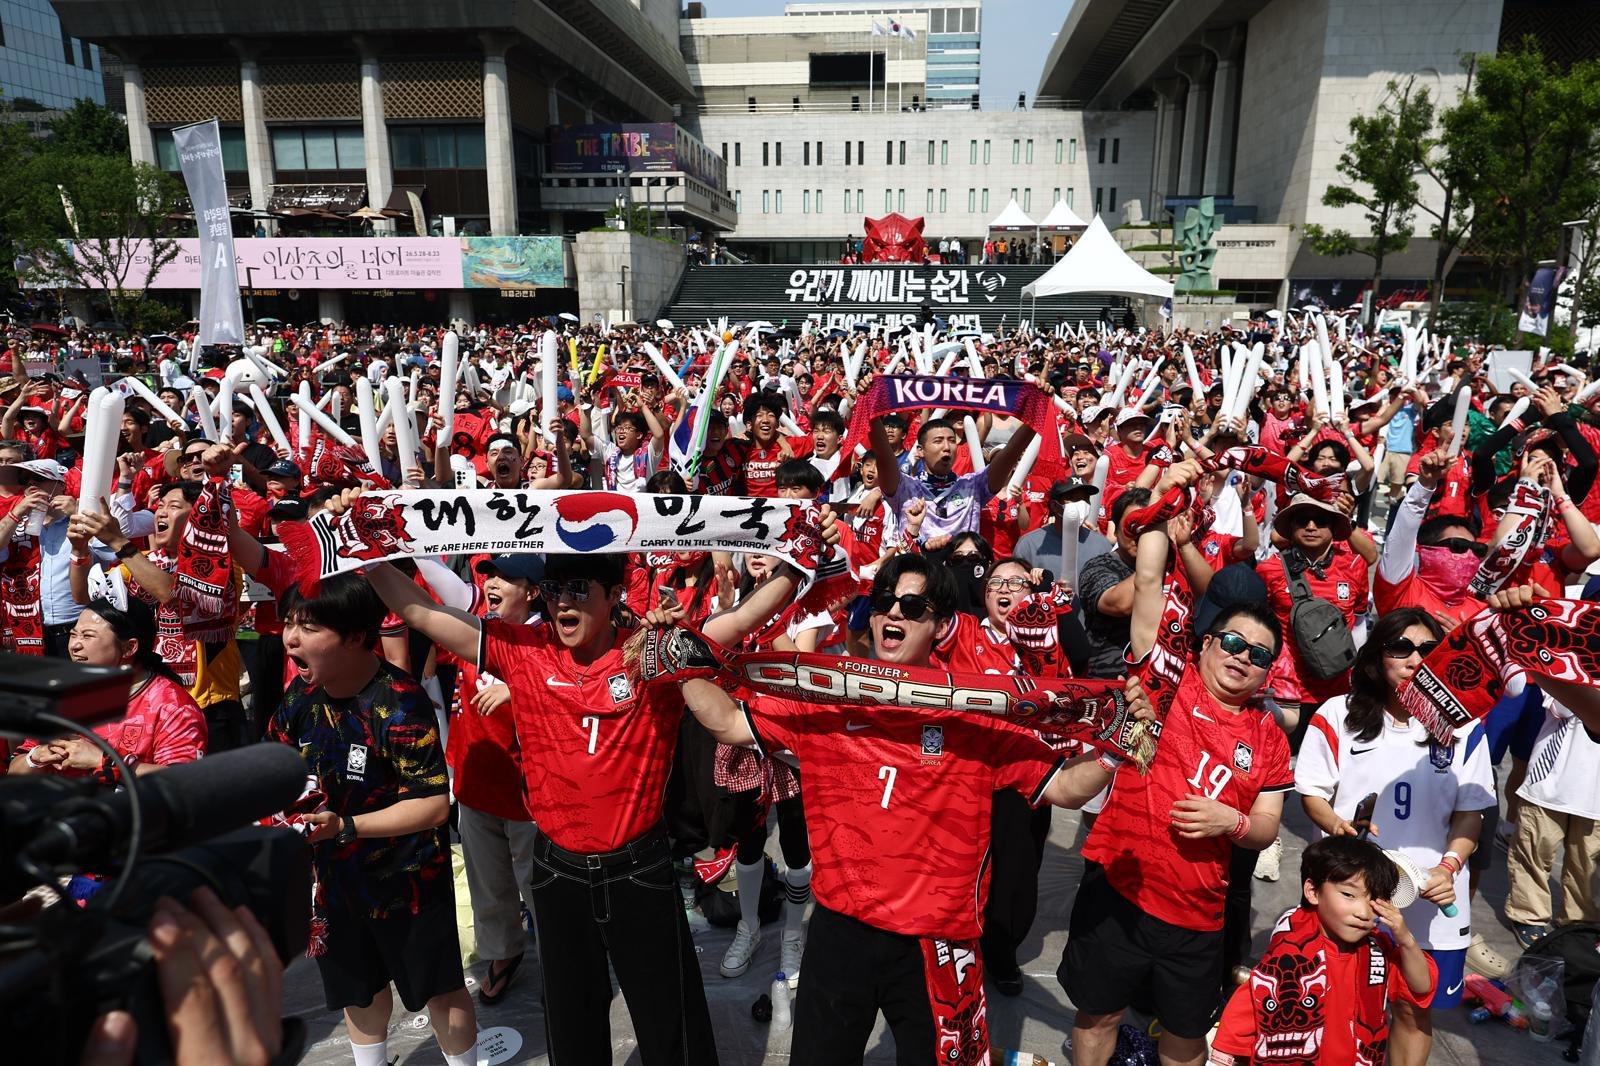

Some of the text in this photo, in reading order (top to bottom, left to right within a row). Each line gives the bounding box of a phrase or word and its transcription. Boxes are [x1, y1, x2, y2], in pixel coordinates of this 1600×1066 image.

[575, 132, 650, 157] THE TRIBE
[361, 246, 402, 280] 넘어
[784, 269, 969, 303] 우리가 깨어나는 순간
[893, 378, 1007, 407] KOREA
[424, 540, 544, 553] WE ARE HERE TOGETHER
[640, 539, 675, 547] CARRY
[677, 539, 691, 547] ON
[717, 540, 771, 550] TOMORROW
[646, 630, 656, 676] ORZA COREA
[845, 661, 901, 678] FOREVER
[582, 715, 600, 754] 7
[920, 759, 941, 767] KOREA
[1186, 750, 1233, 800] 19
[878, 765, 897, 809] 7
[1394, 781, 1412, 820] 9
